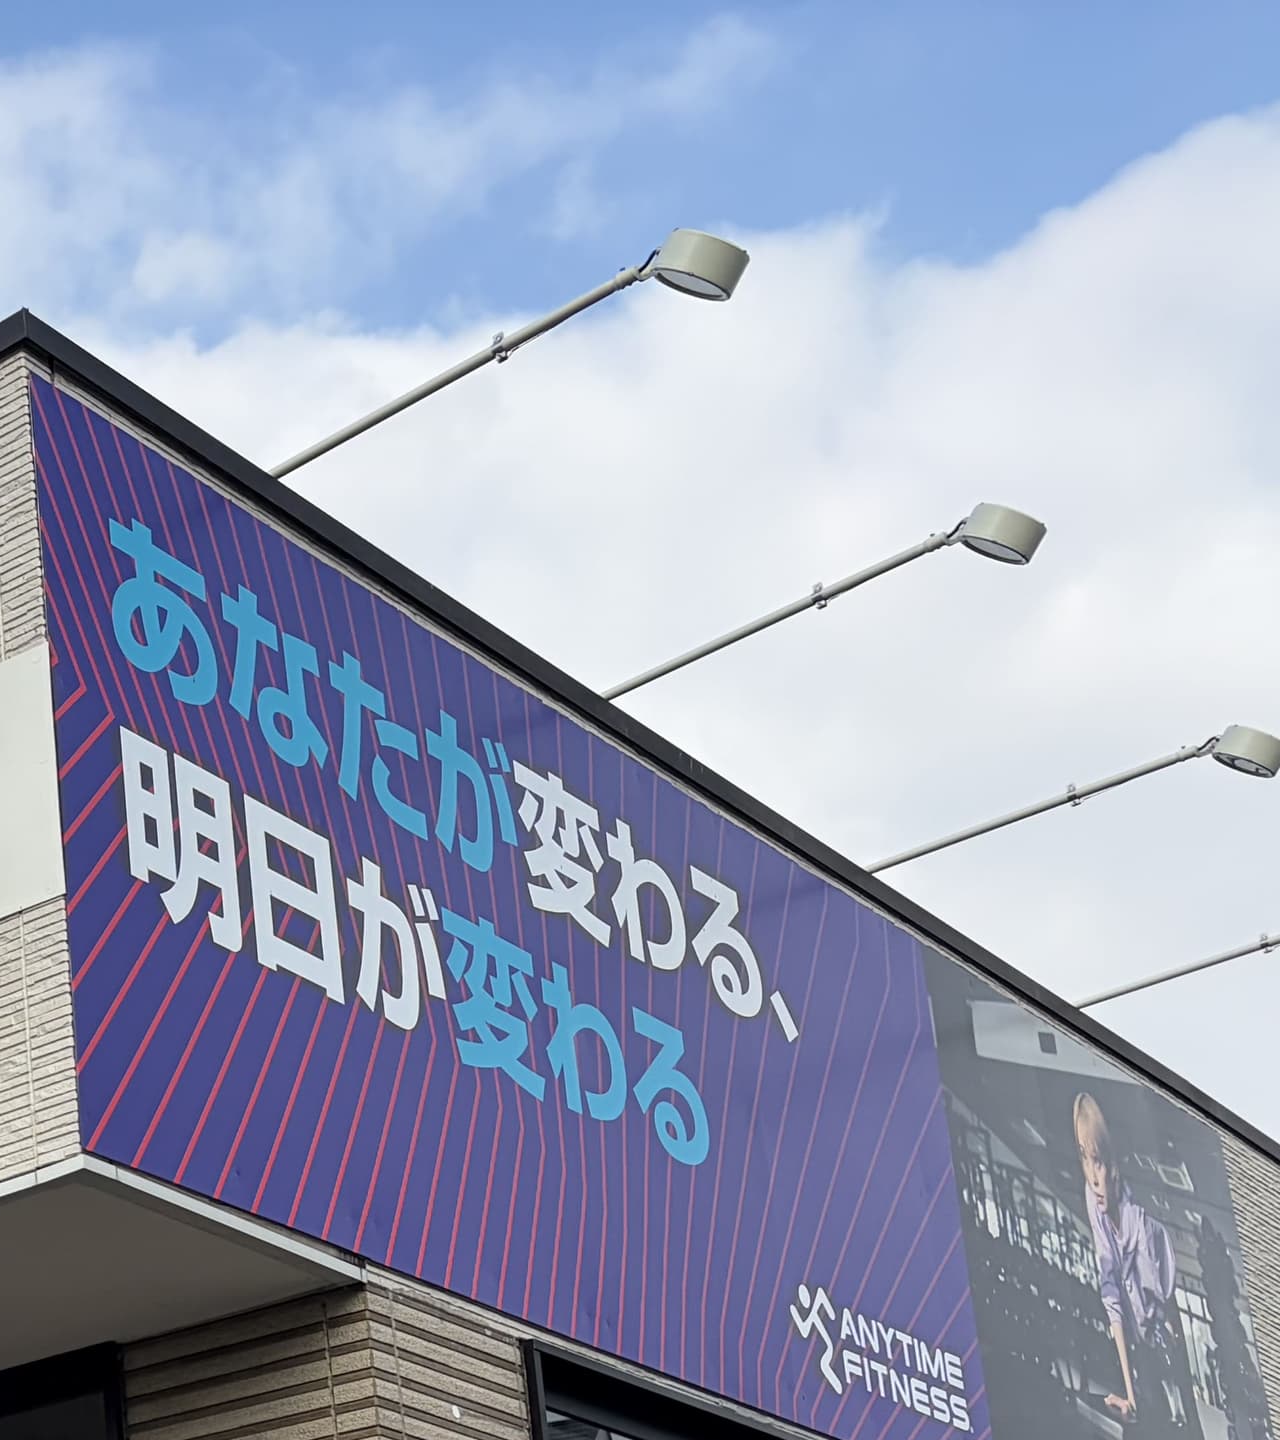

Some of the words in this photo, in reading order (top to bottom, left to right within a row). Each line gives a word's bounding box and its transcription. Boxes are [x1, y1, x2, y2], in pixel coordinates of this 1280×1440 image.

[109, 518, 800, 1043] あなたが変わる、
[120, 726, 710, 1166] 明日が変わる
[841, 1308, 965, 1390] ANYTIME
[843, 1350, 971, 1432] FITNESS
